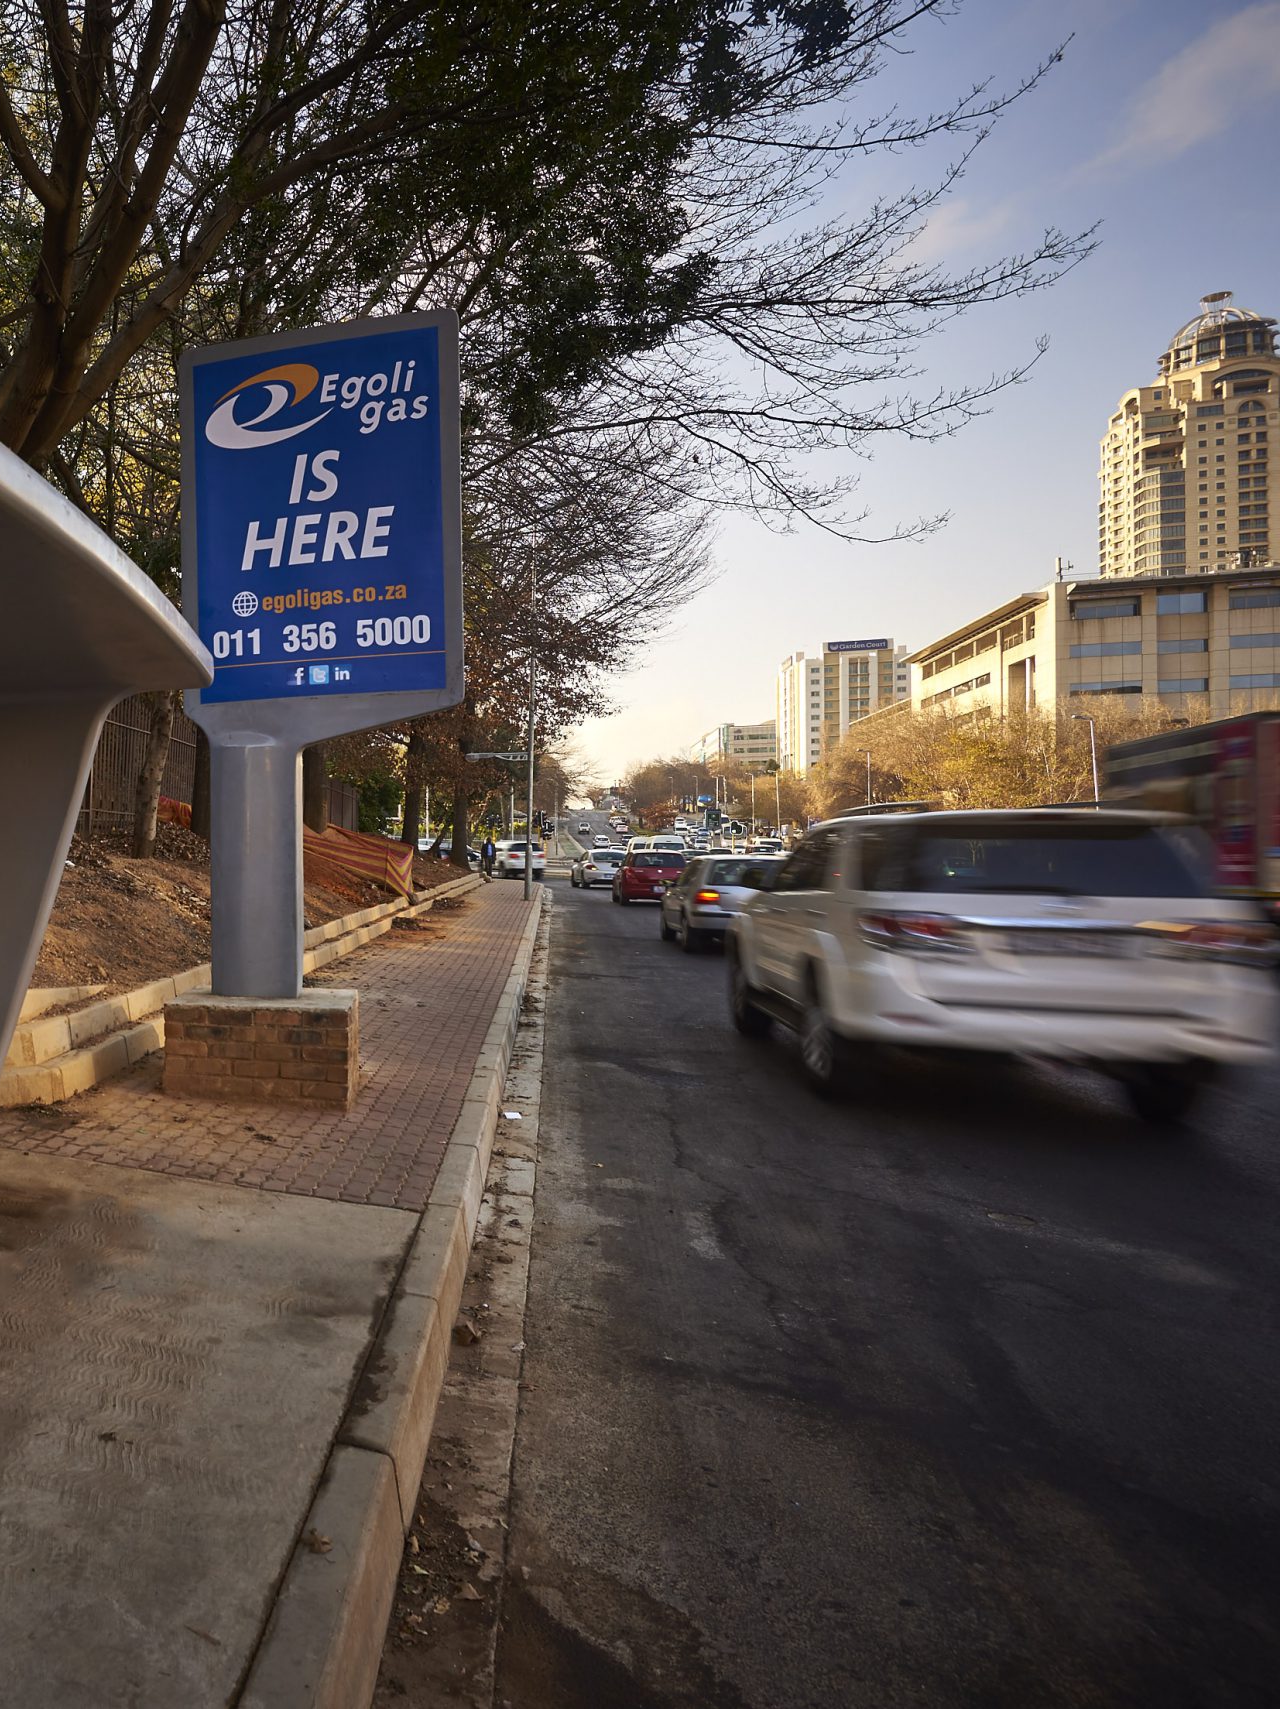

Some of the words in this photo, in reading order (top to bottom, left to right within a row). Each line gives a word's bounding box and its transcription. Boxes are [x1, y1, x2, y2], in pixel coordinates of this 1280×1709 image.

[320, 360, 417, 410] Egoli
[359, 394, 430, 435] gas
[288, 449, 340, 504] IS
[241, 505, 395, 571] HERE
[261, 584, 408, 614] egoligas.co.za
[213, 629, 261, 659] 011
[283, 621, 337, 653] 356
[356, 614, 431, 646] 5000
[840, 642, 865, 650] Garden
[866, 640, 886, 649] Court
